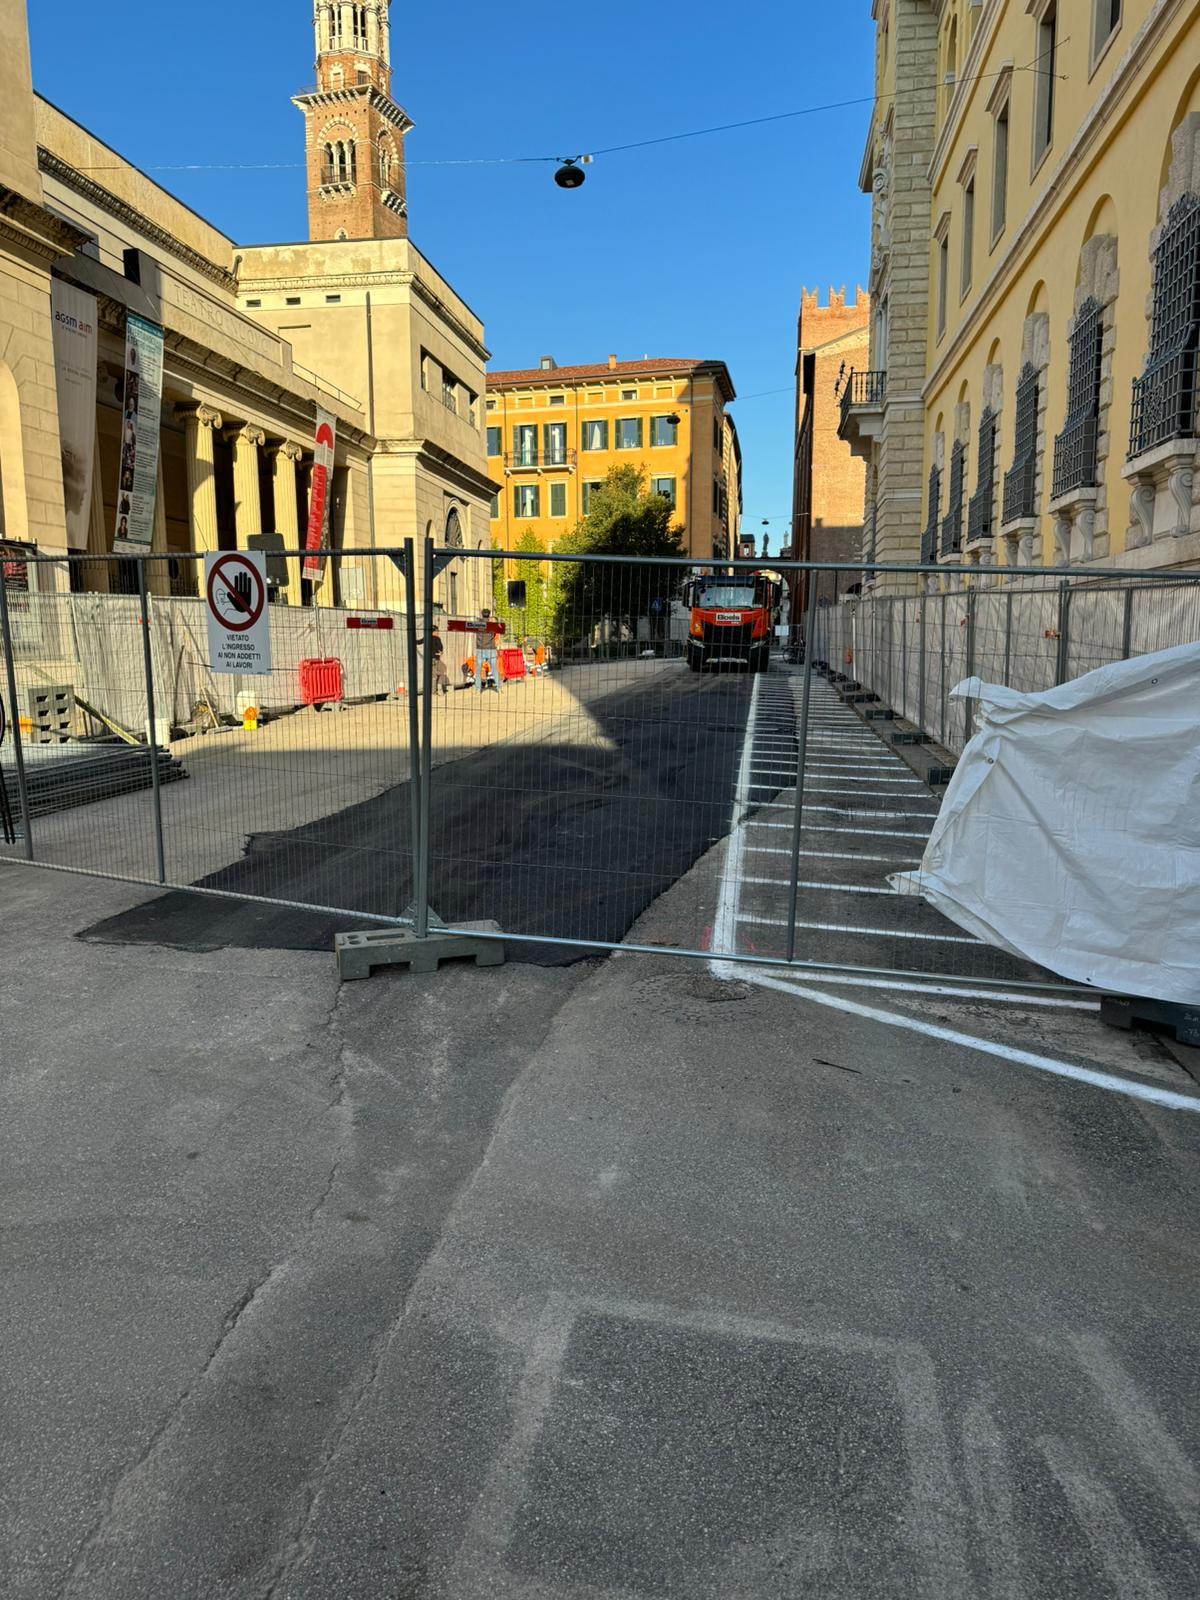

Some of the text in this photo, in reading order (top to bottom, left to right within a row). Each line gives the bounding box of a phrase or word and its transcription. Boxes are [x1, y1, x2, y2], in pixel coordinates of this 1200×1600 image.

[174, 284, 223, 326] TEATRO
[78, 320, 93, 334] aim
[221, 643, 255, 651] L'INGRESSO
[237, 652, 261, 660] ADDETTI
